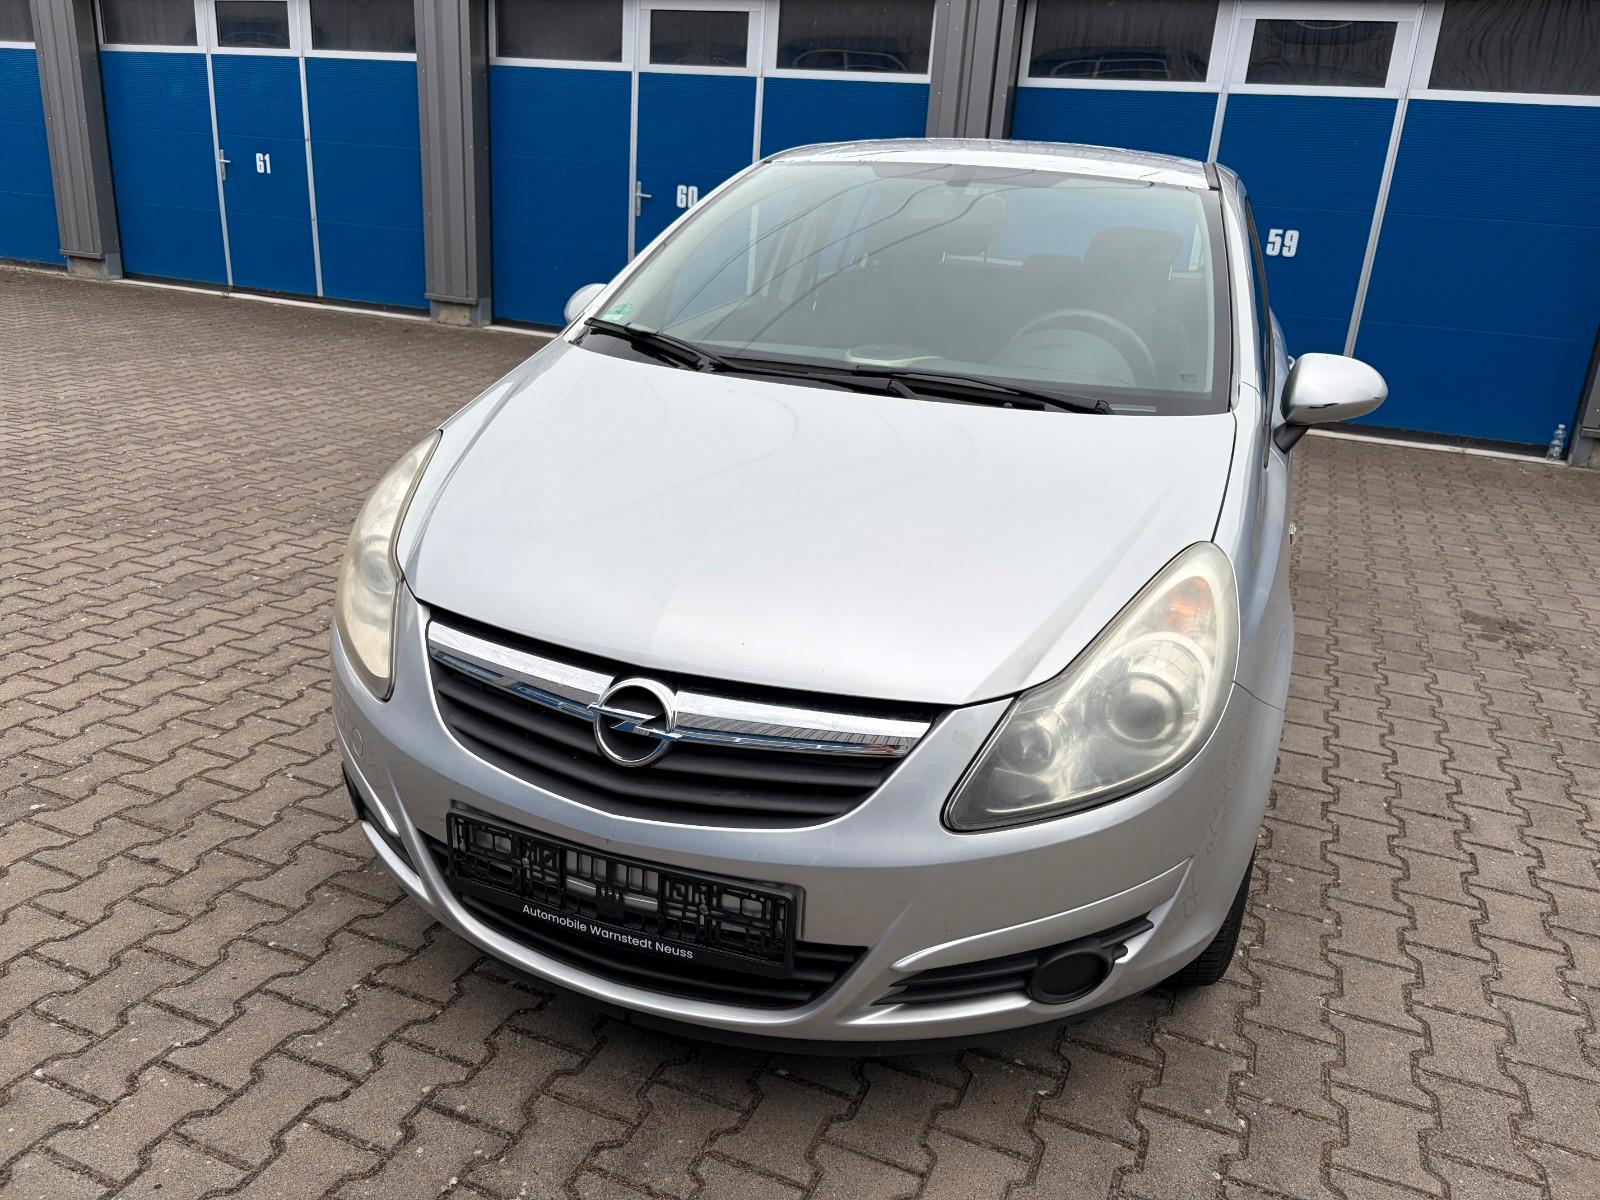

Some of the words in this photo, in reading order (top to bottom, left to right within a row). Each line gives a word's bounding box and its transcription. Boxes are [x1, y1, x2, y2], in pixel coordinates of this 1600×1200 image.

[255, 152, 271, 174] 61
[676, 184, 699, 209] 60
[1265, 228, 1300, 258] 59
[522, 904, 587, 932] Automobile
[590, 924, 653, 950] Warnstedt
[655, 941, 694, 959] Neuss
